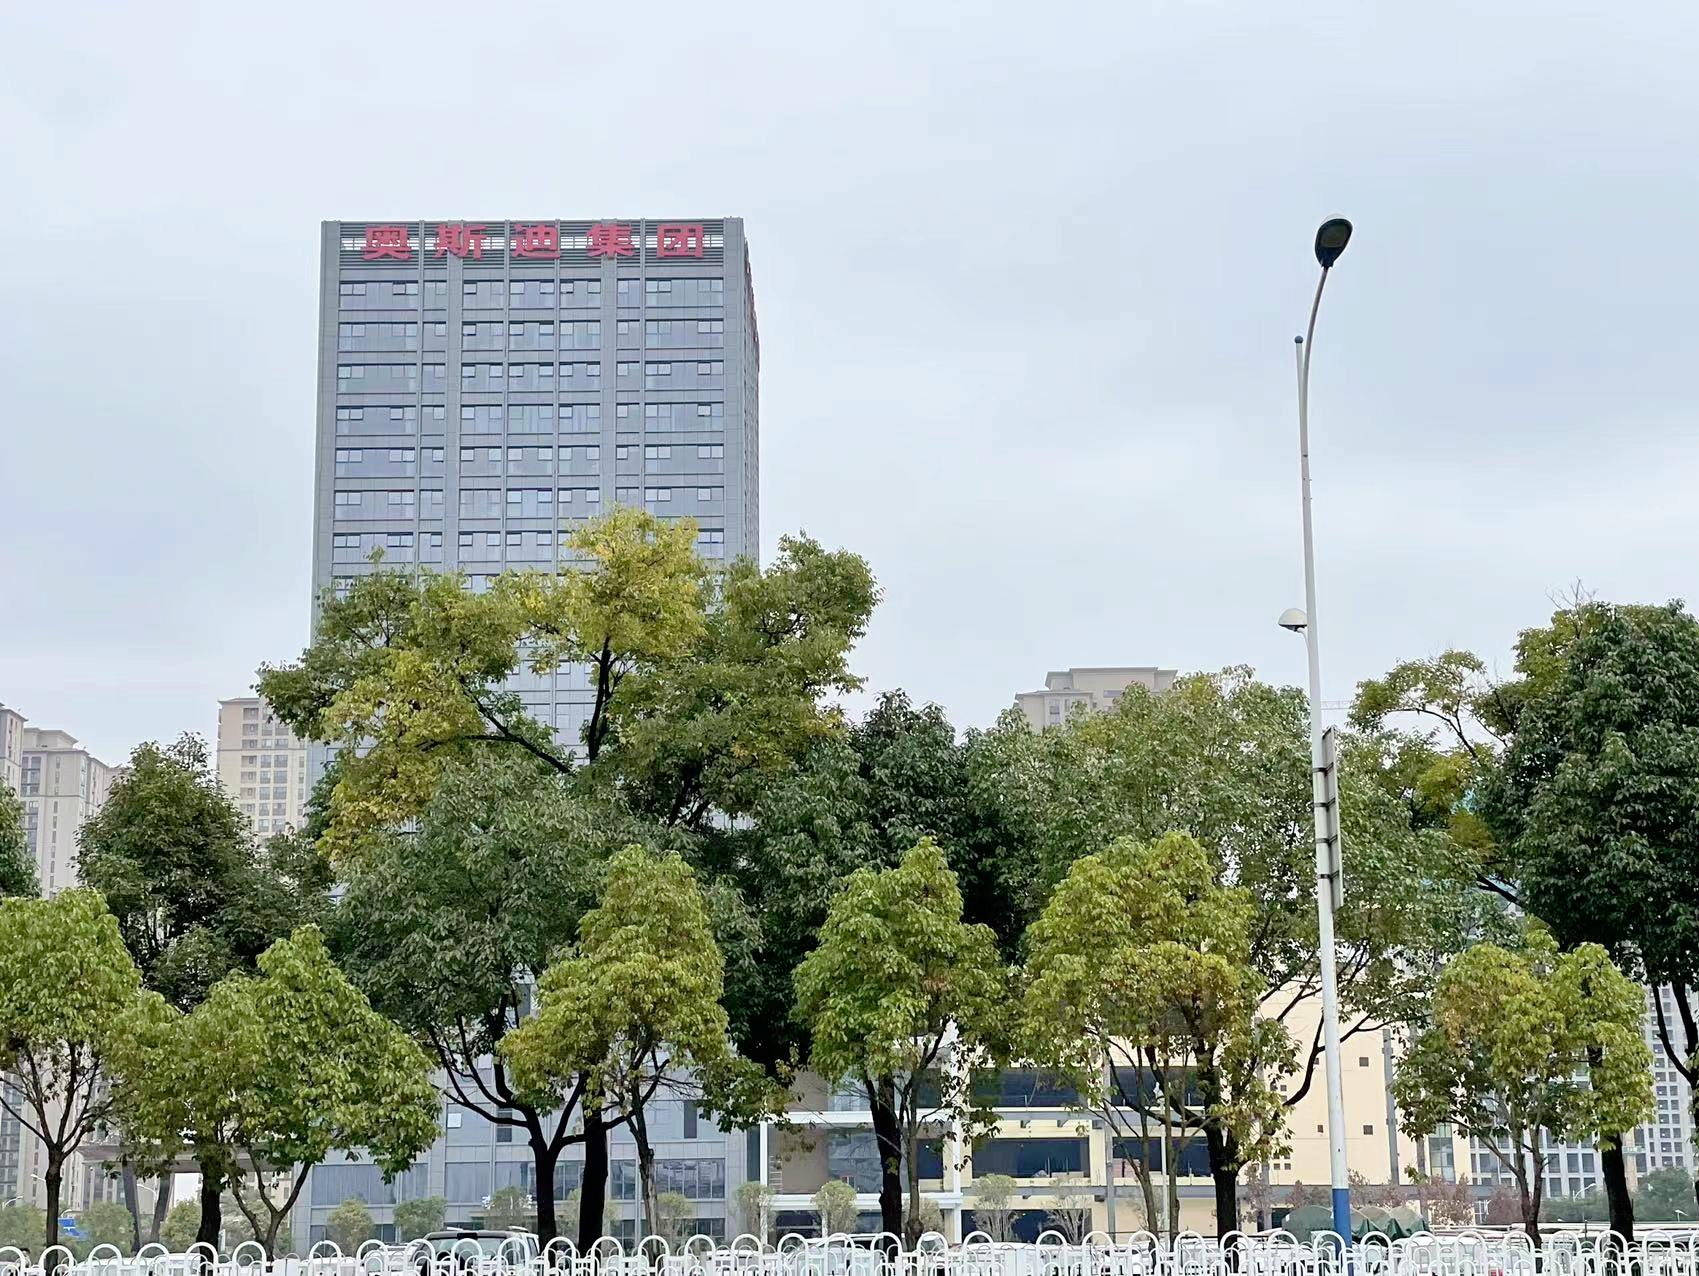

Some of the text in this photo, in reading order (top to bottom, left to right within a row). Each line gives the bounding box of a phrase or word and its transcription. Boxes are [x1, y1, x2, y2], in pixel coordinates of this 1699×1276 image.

[361, 223, 704, 260] 奥斯迪集团
